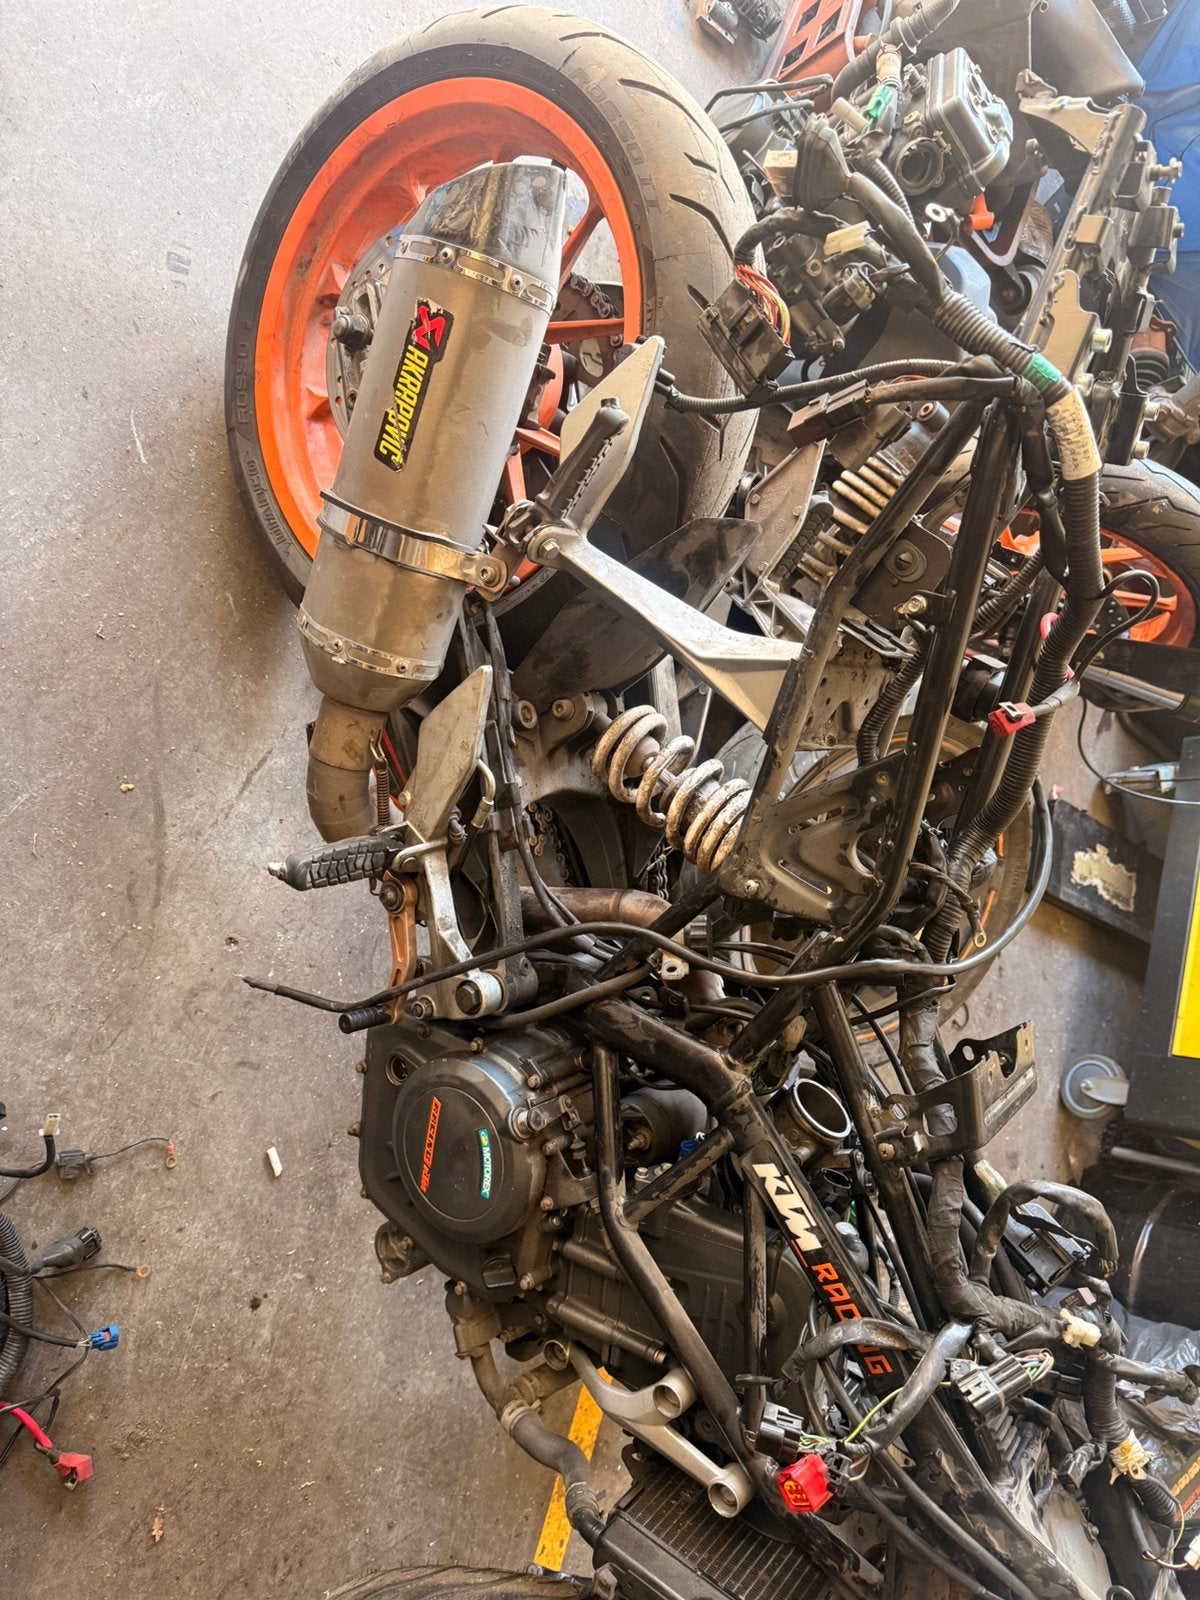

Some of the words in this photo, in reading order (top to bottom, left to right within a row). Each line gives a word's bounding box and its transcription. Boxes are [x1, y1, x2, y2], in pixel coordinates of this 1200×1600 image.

[570, 67, 645, 166] ROSSO
[236, 342, 249, 424] ROSSO
[481, 1147, 492, 1195] MOTOREX
[752, 1163, 823, 1251] KTM
